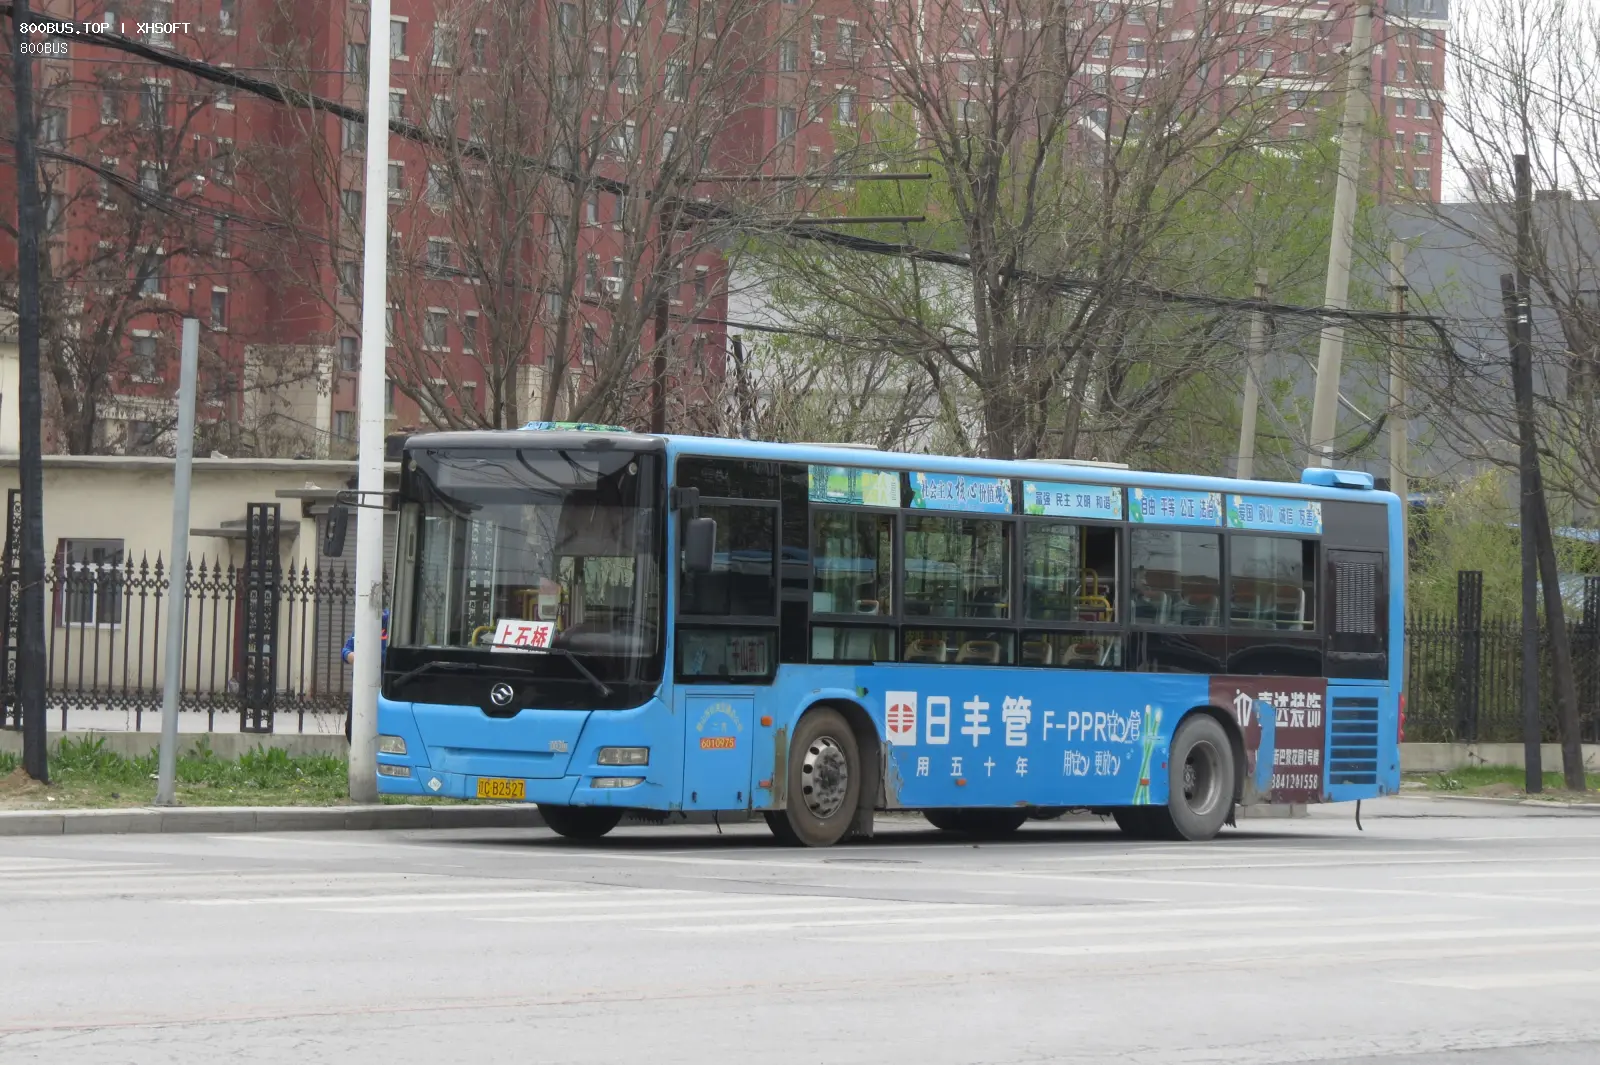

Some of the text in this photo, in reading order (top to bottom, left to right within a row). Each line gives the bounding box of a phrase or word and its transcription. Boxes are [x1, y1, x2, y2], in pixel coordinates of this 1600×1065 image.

[1035, 491, 1111, 510] 富强 民主 文明 和谐
[1141, 496, 1156, 516] 自由
[1160, 496, 1175, 517] 平等
[1180, 497, 1195, 518] 公正
[1238, 503, 1253, 522] 爱国
[1258, 504, 1274, 523] 敬业
[1279, 506, 1294, 525] 诚信
[495, 624, 549, 649] 上石桥
[926, 694, 1032, 748] 日丰管
[701, 737, 735, 749] 6010975
